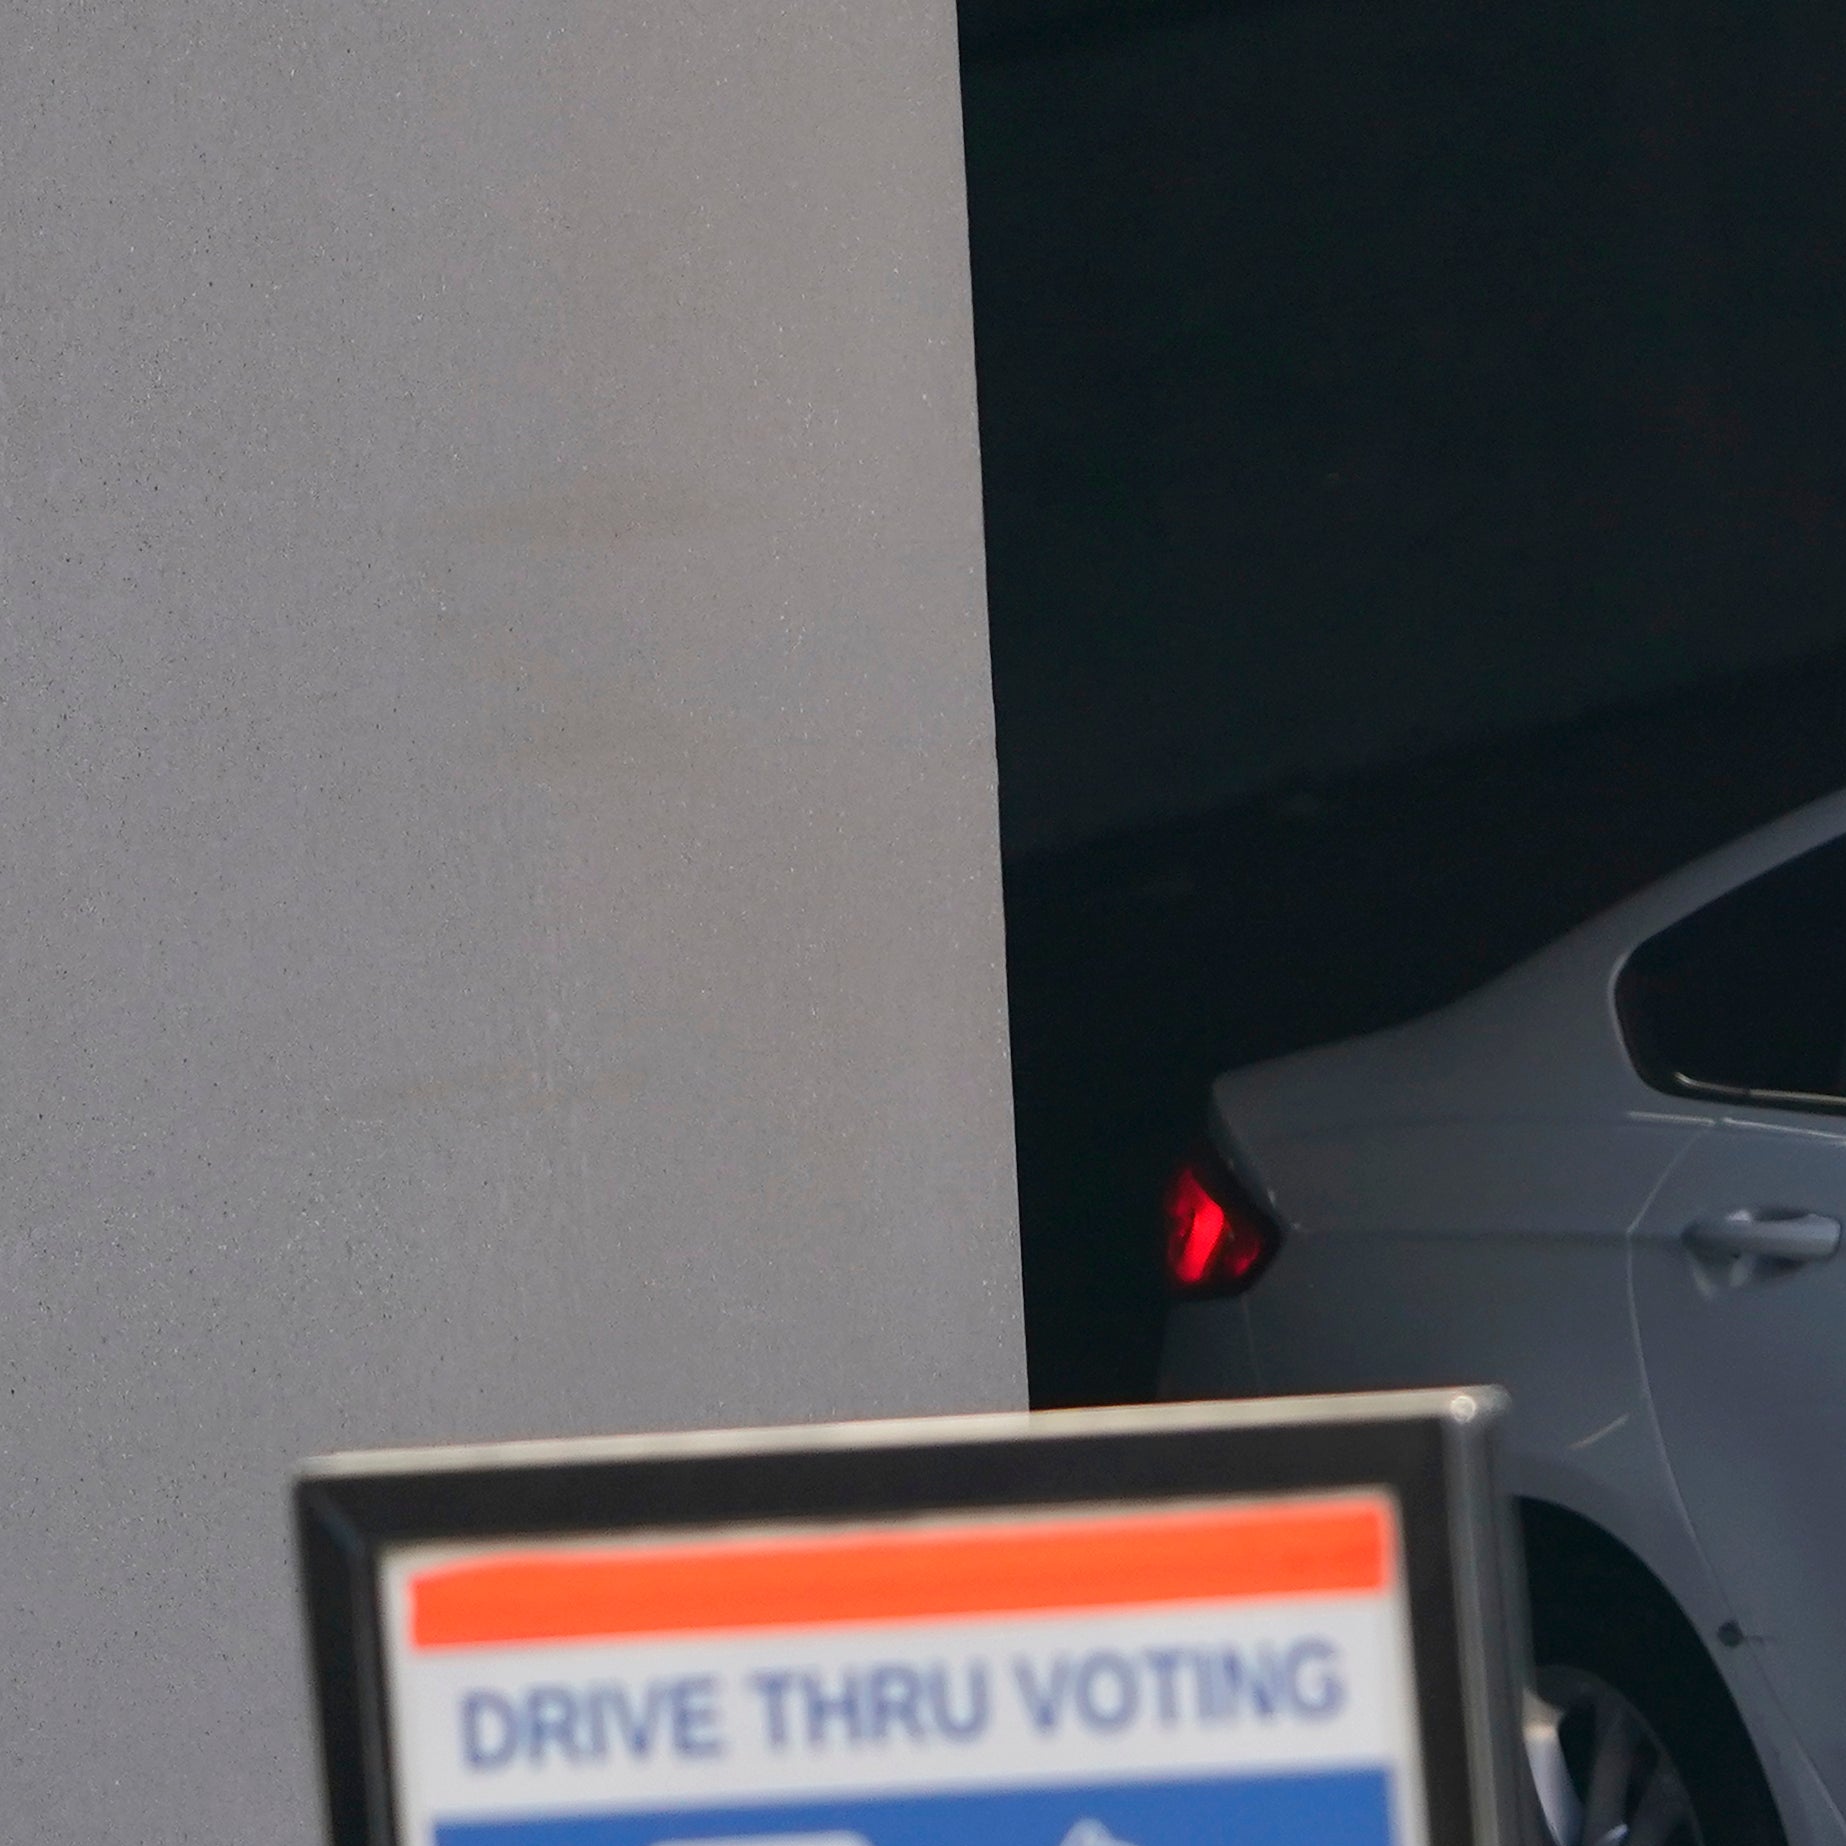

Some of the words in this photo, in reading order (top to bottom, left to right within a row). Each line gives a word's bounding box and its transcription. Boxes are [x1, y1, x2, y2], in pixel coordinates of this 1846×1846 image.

[460, 1668, 728, 1774] DRIVE
[750, 1656, 989, 1758] THRU
[1011, 1634, 1350, 1739] VOTING
